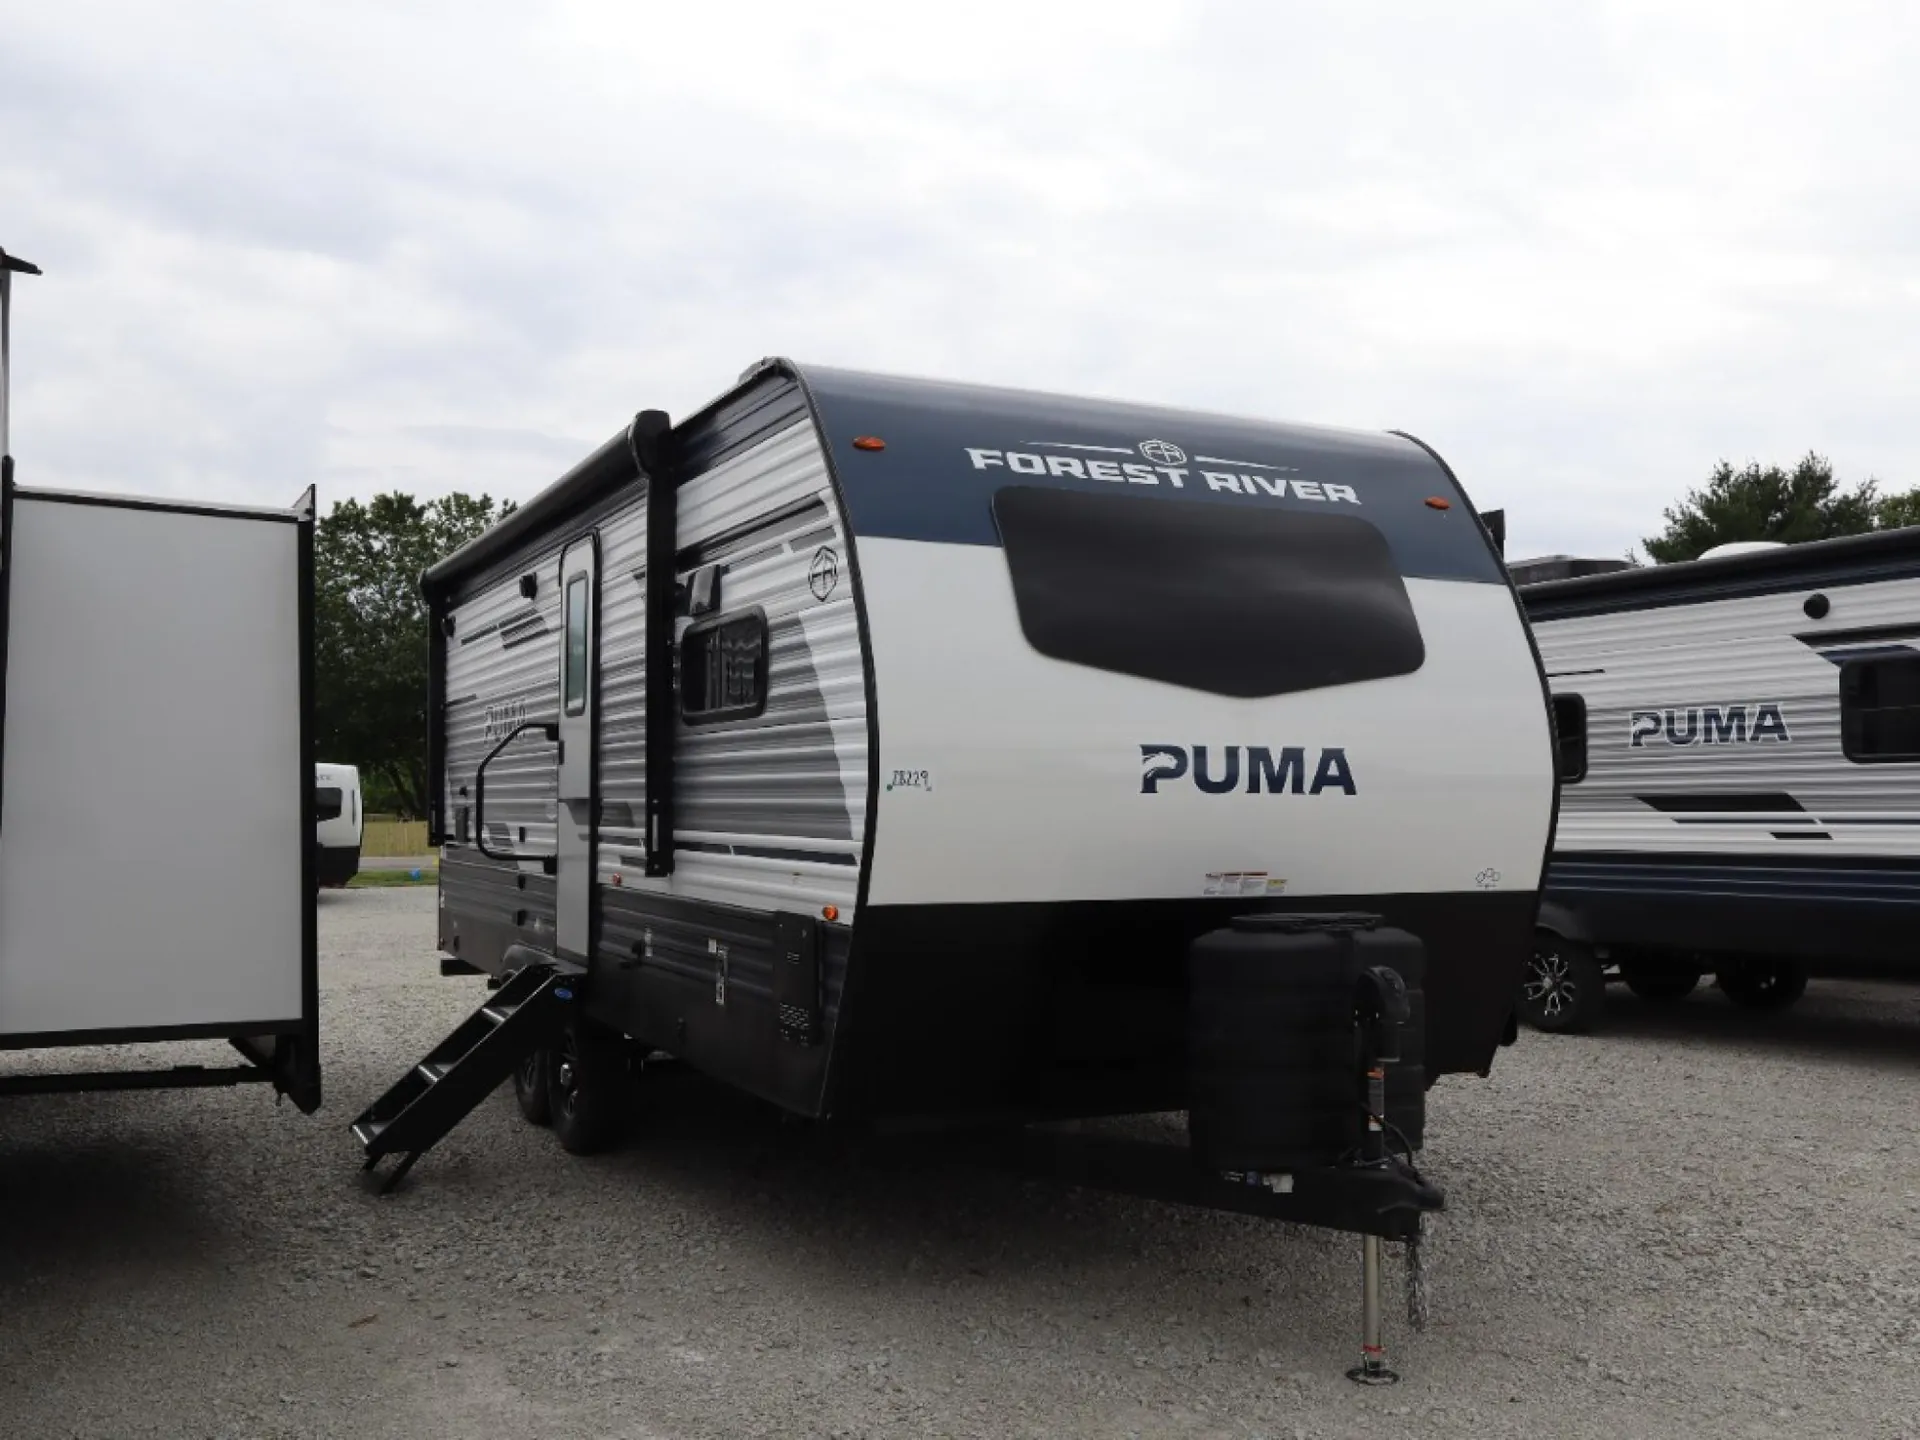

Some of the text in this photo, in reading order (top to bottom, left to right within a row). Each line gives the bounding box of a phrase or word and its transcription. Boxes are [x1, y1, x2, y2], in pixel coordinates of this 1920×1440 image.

[963, 447, 1362, 505] FOREST RIVER
[1629, 703, 1791, 748] PUMA
[1139, 744, 1357, 795] PUMA
